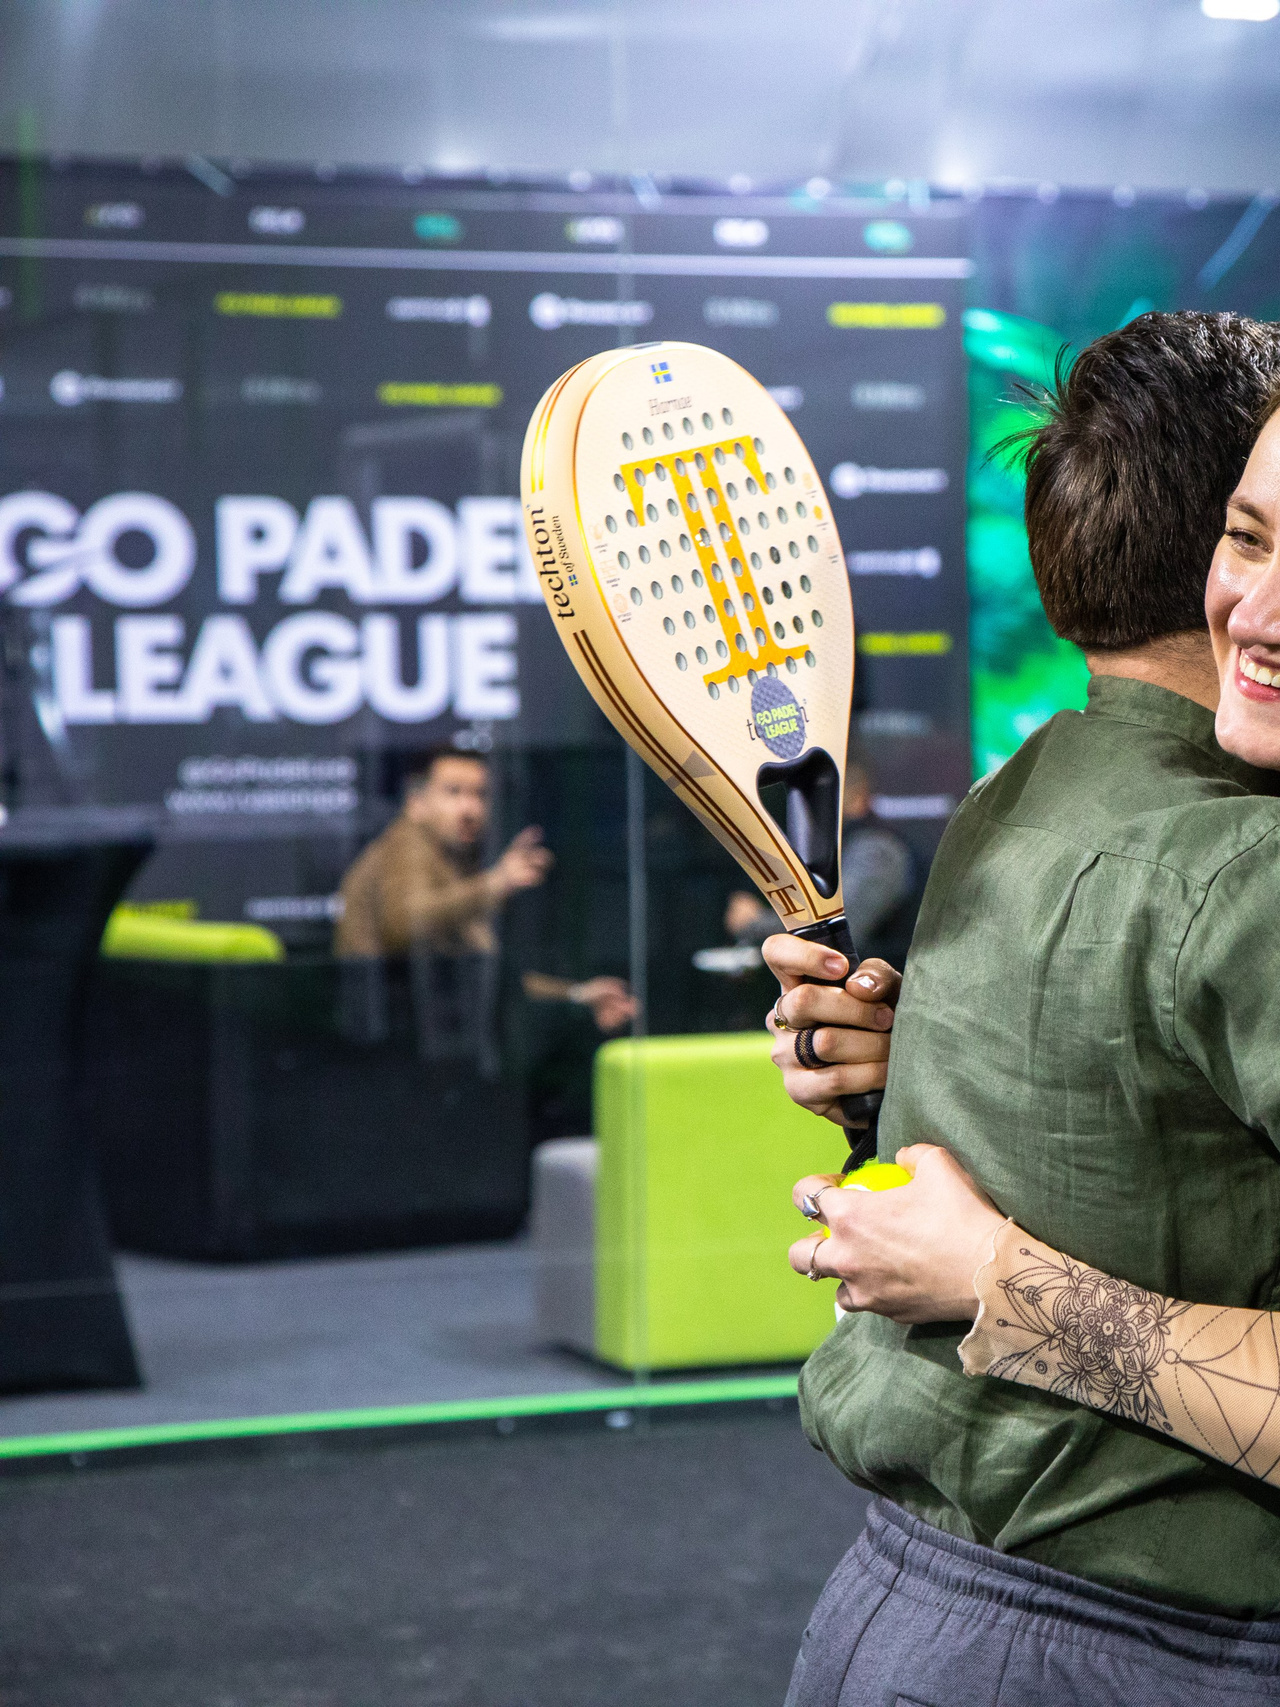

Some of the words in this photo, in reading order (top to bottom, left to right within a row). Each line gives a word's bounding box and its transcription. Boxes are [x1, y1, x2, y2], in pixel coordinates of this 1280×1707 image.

[0, 490, 197, 606] GO
[552, 515, 570, 560] Sweden
[531, 506, 576, 620] techton
[562, 561, 576, 573] of
[53, 609, 520, 726] LEAGUE
[756, 710, 773, 727] GO
[770, 703, 799, 721] PADEL
[765, 718, 800, 739] LEAGUE
